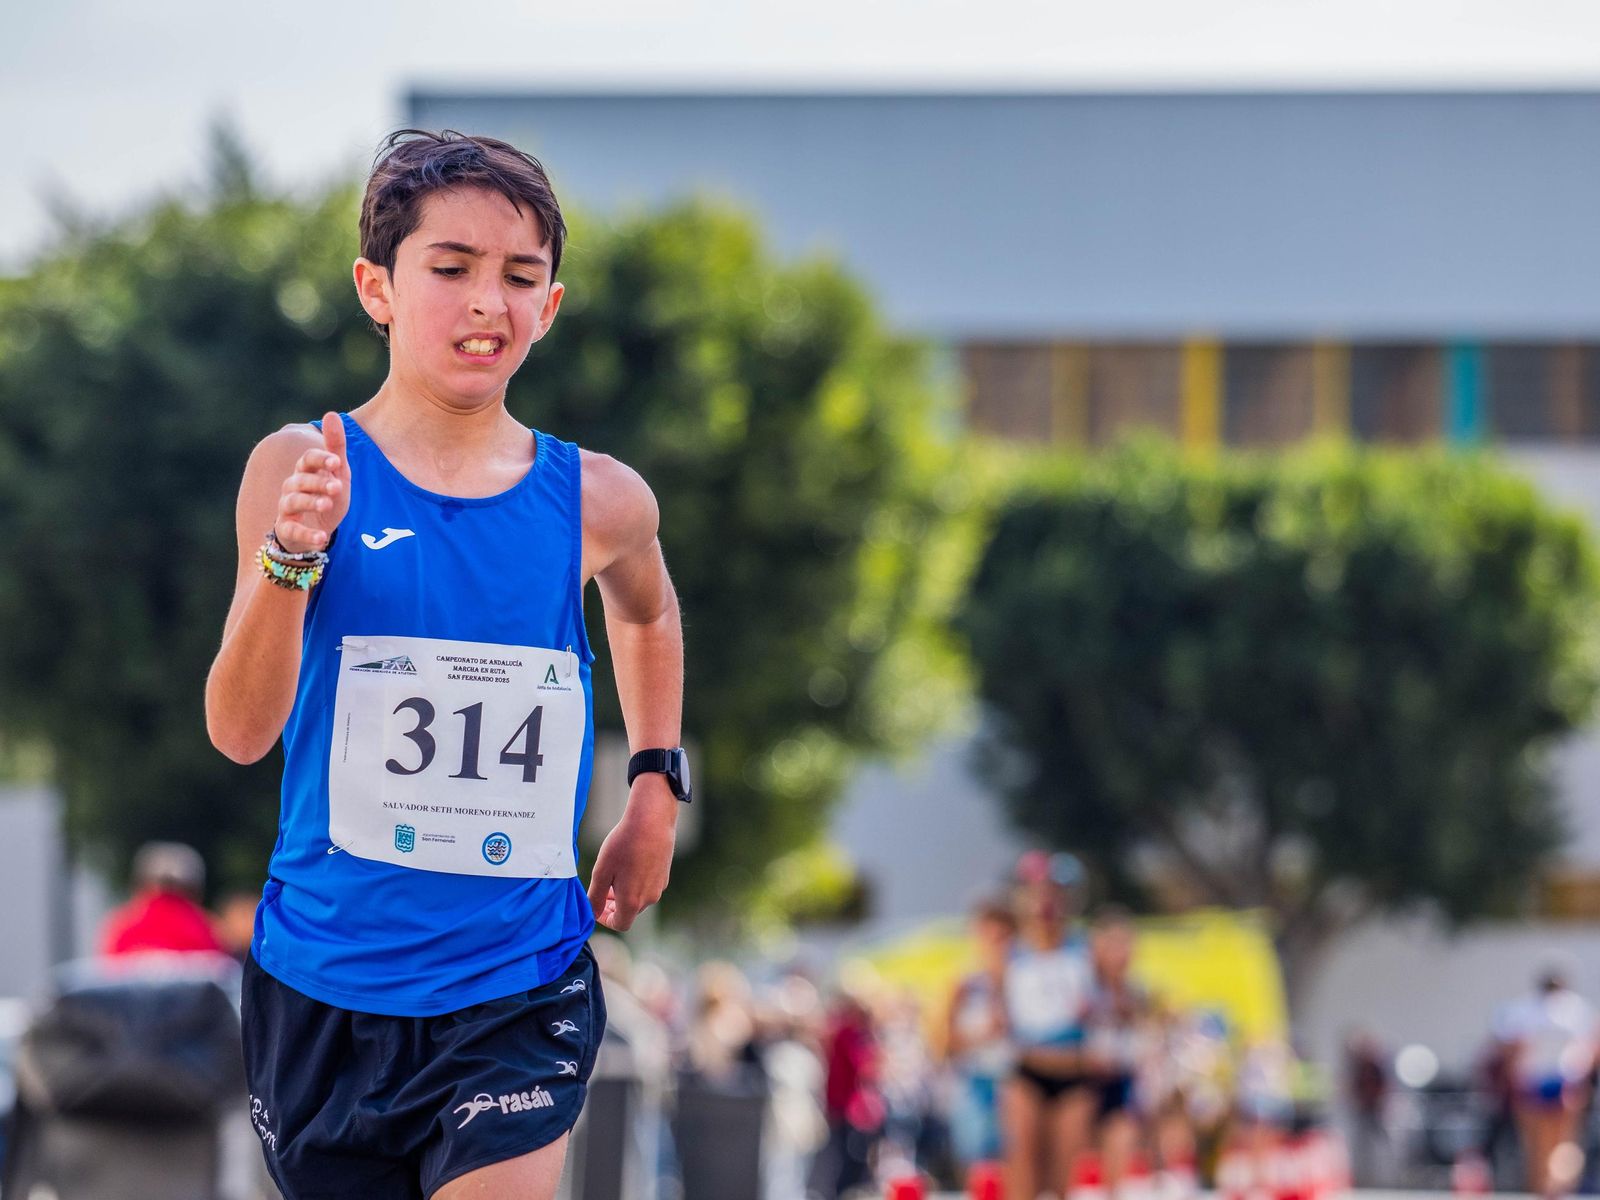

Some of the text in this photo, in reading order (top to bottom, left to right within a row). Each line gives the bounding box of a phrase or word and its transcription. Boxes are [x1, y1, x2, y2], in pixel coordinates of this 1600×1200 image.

[436, 655, 479, 664] CAMPEONATO
[489, 659, 523, 667] ANDALUCÍA
[453, 665, 479, 673] MARCHA
[461, 674, 494, 683] FERNANDO
[385, 696, 544, 783] 314
[382, 801, 536, 819] SALVADOR SETH MORENO FERNANDEZ
[499, 1085, 555, 1114] rasán
